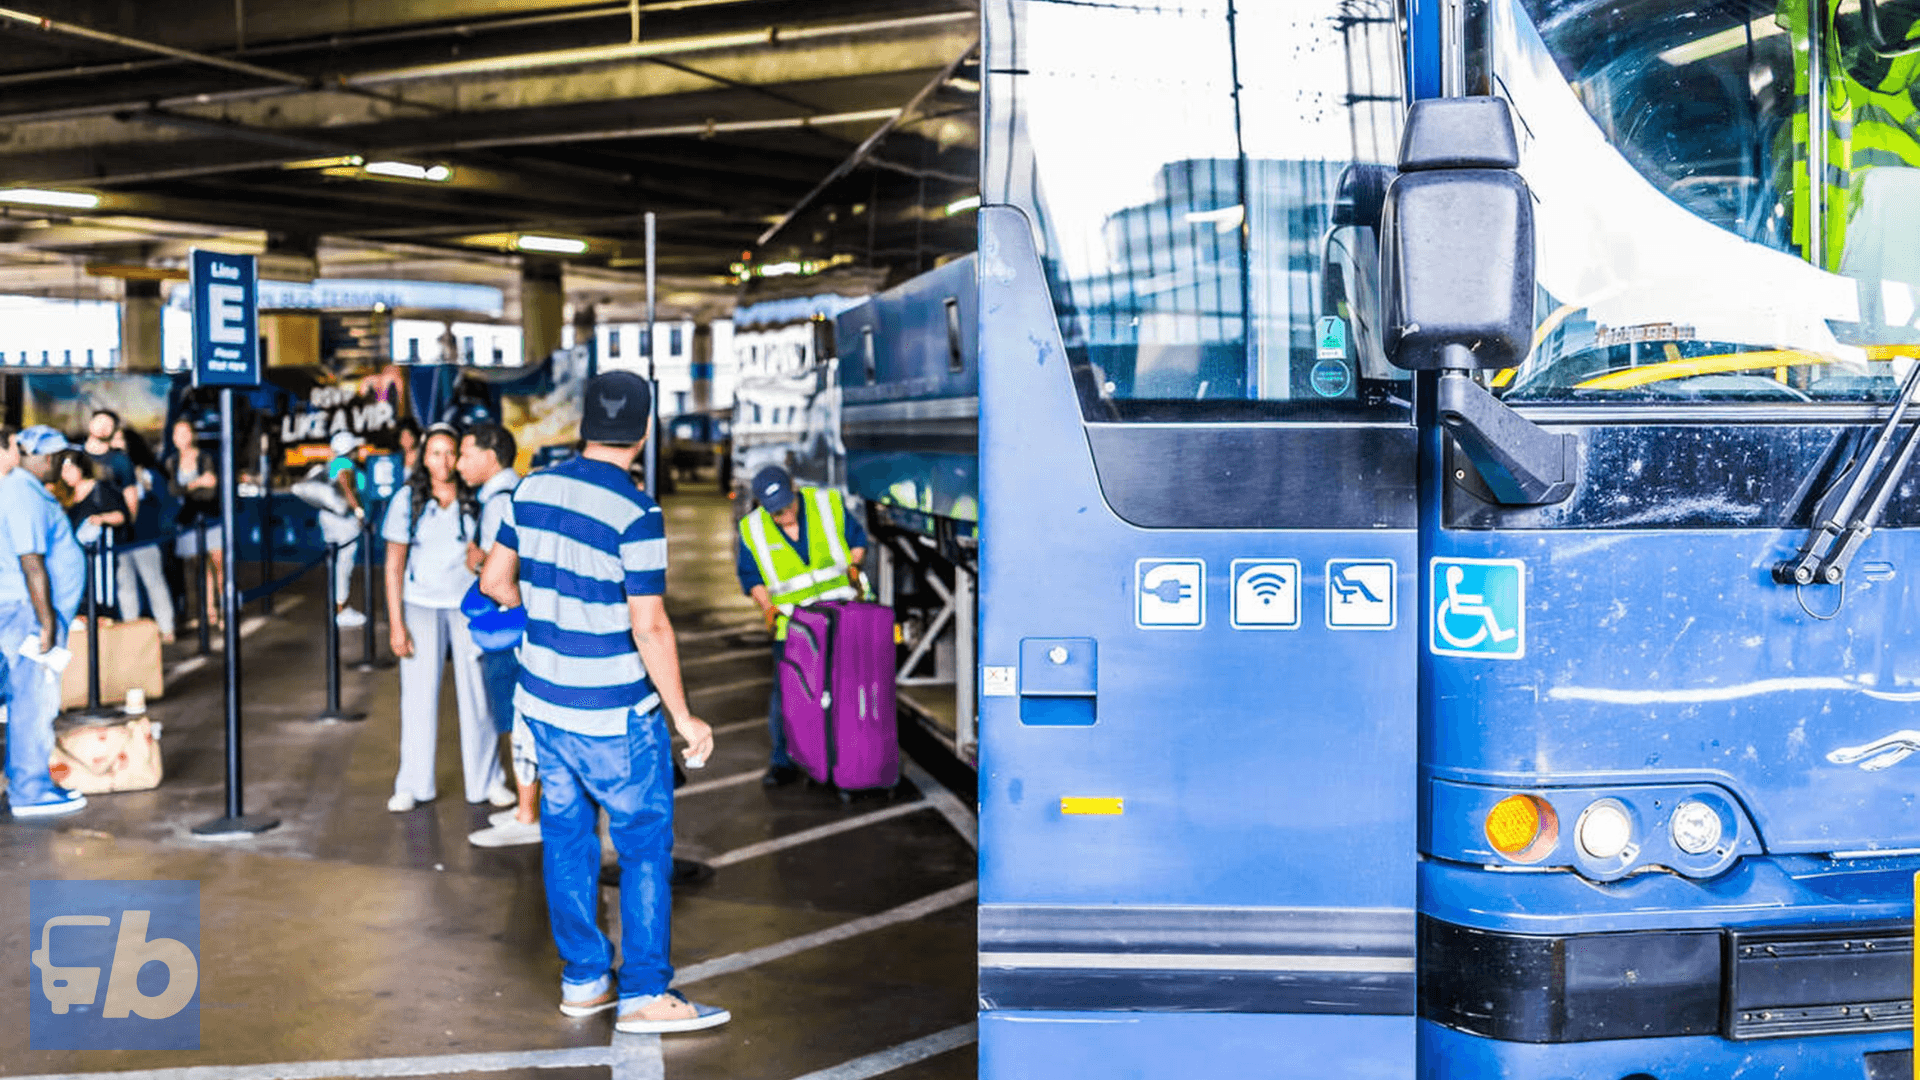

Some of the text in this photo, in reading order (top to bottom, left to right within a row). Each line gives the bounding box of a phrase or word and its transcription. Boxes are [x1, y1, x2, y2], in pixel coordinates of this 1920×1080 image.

[211, 261, 240, 280] Line
[208, 283, 246, 344] E
[1324, 318, 1336, 334] 7
[281, 411, 328, 443] LIKE
[329, 408, 349, 436] A
